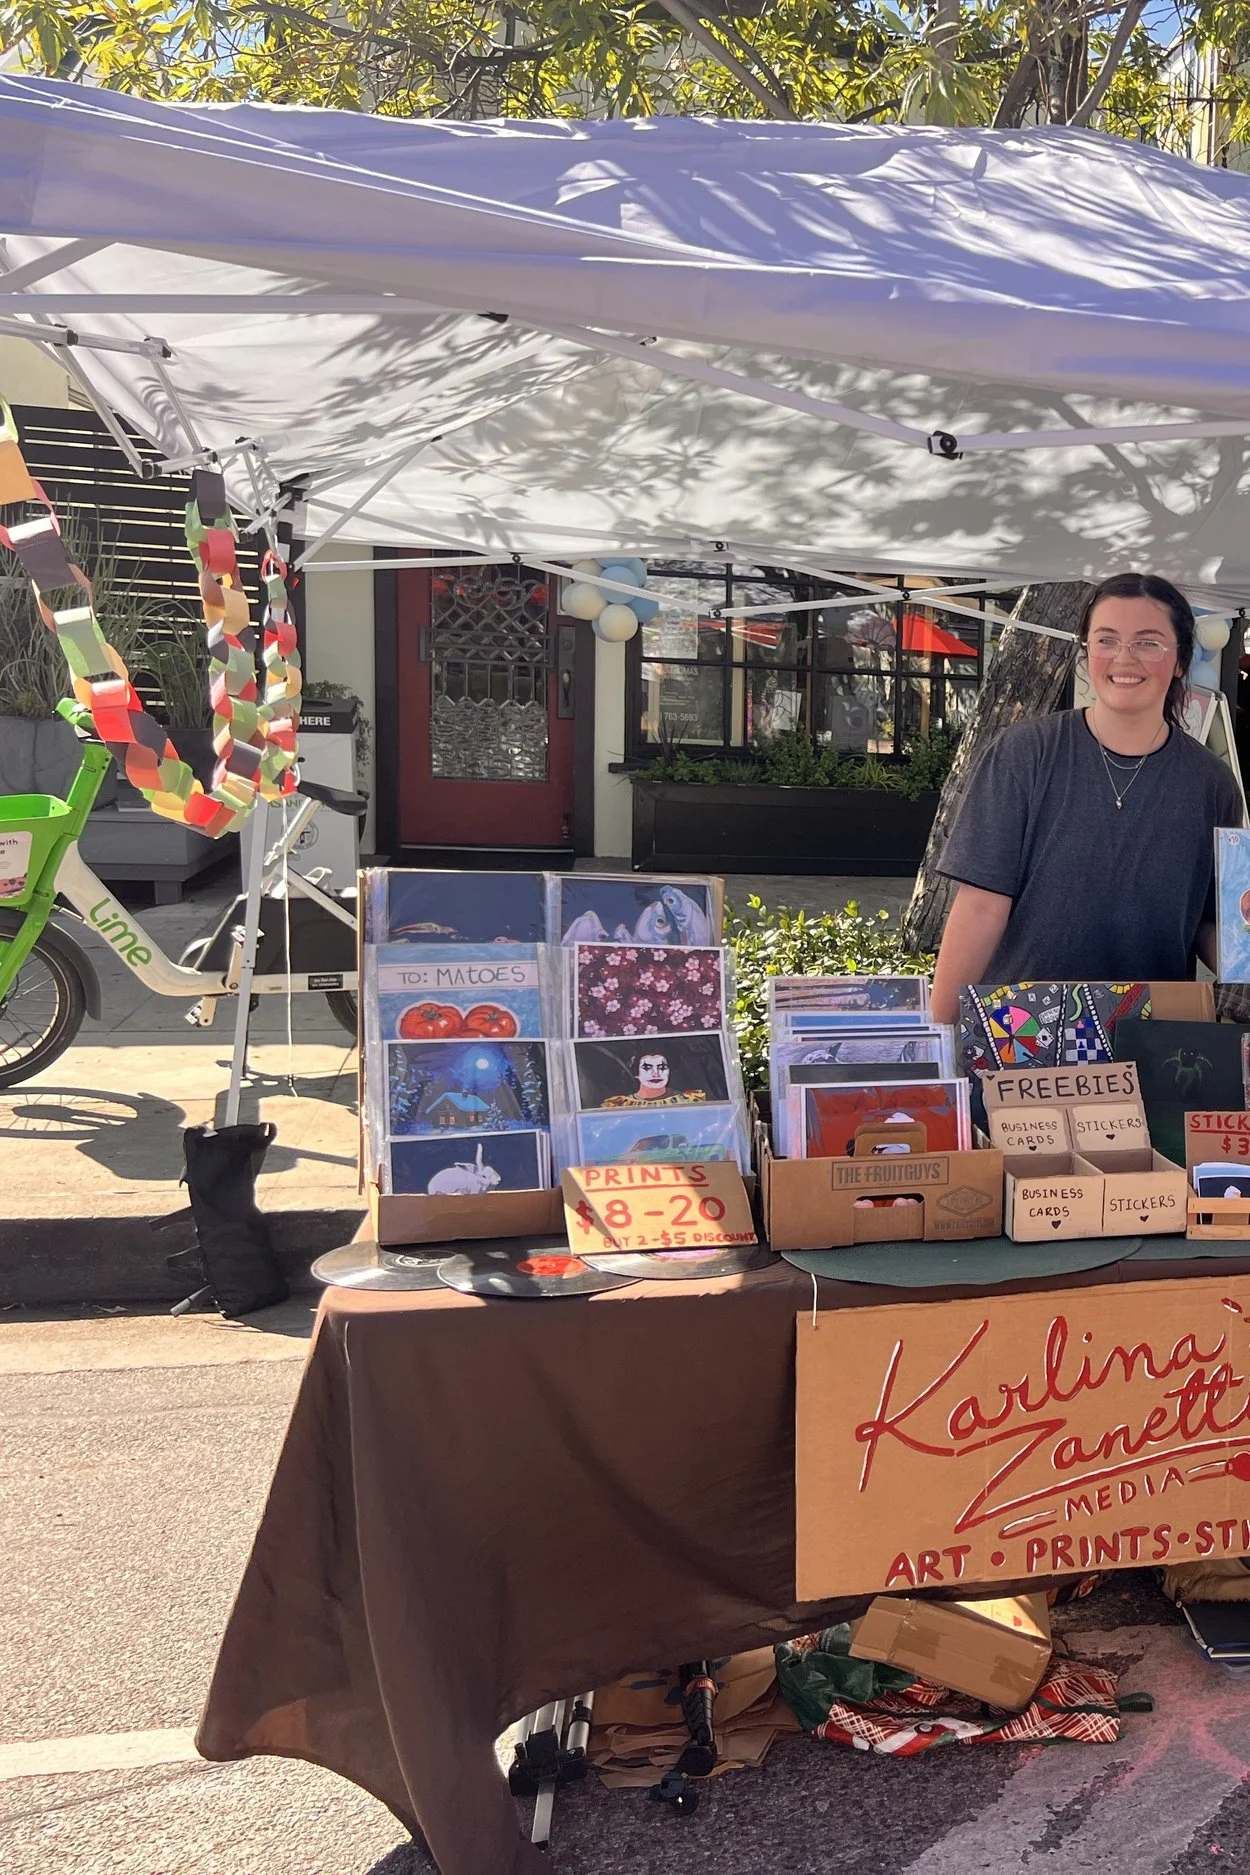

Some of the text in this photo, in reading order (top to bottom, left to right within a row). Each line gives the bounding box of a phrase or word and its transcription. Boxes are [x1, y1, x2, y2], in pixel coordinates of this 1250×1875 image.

[299, 716, 331, 726] HERE
[89, 897, 152, 967] Lime
[397, 971, 428, 985] TO:
[997, 1071, 1135, 1101] FREEBIES
[1001, 1120, 1058, 1133] BUSINESS
[1076, 1117, 1143, 1133] STICKERS
[1007, 1134, 1055, 1147] CARDS
[585, 1165, 707, 1187] PRINTS
[837, 1162, 941, 1183] THE FRUITGUYS
[1022, 1188, 1084, 1200] BUSINESS
[1029, 1206, 1070, 1218] CARDS
[1109, 1195, 1176, 1212] STICKERS
[603, 1236, 631, 1250] BUY
[693, 1232, 756, 1243] DISCOUNT
[855, 1315, 1226, 1493] Karlina
[1064, 1466, 1186, 1521] MEDIA
[885, 1545, 972, 1588] ART
[1026, 1525, 1178, 1573] PRINTS
